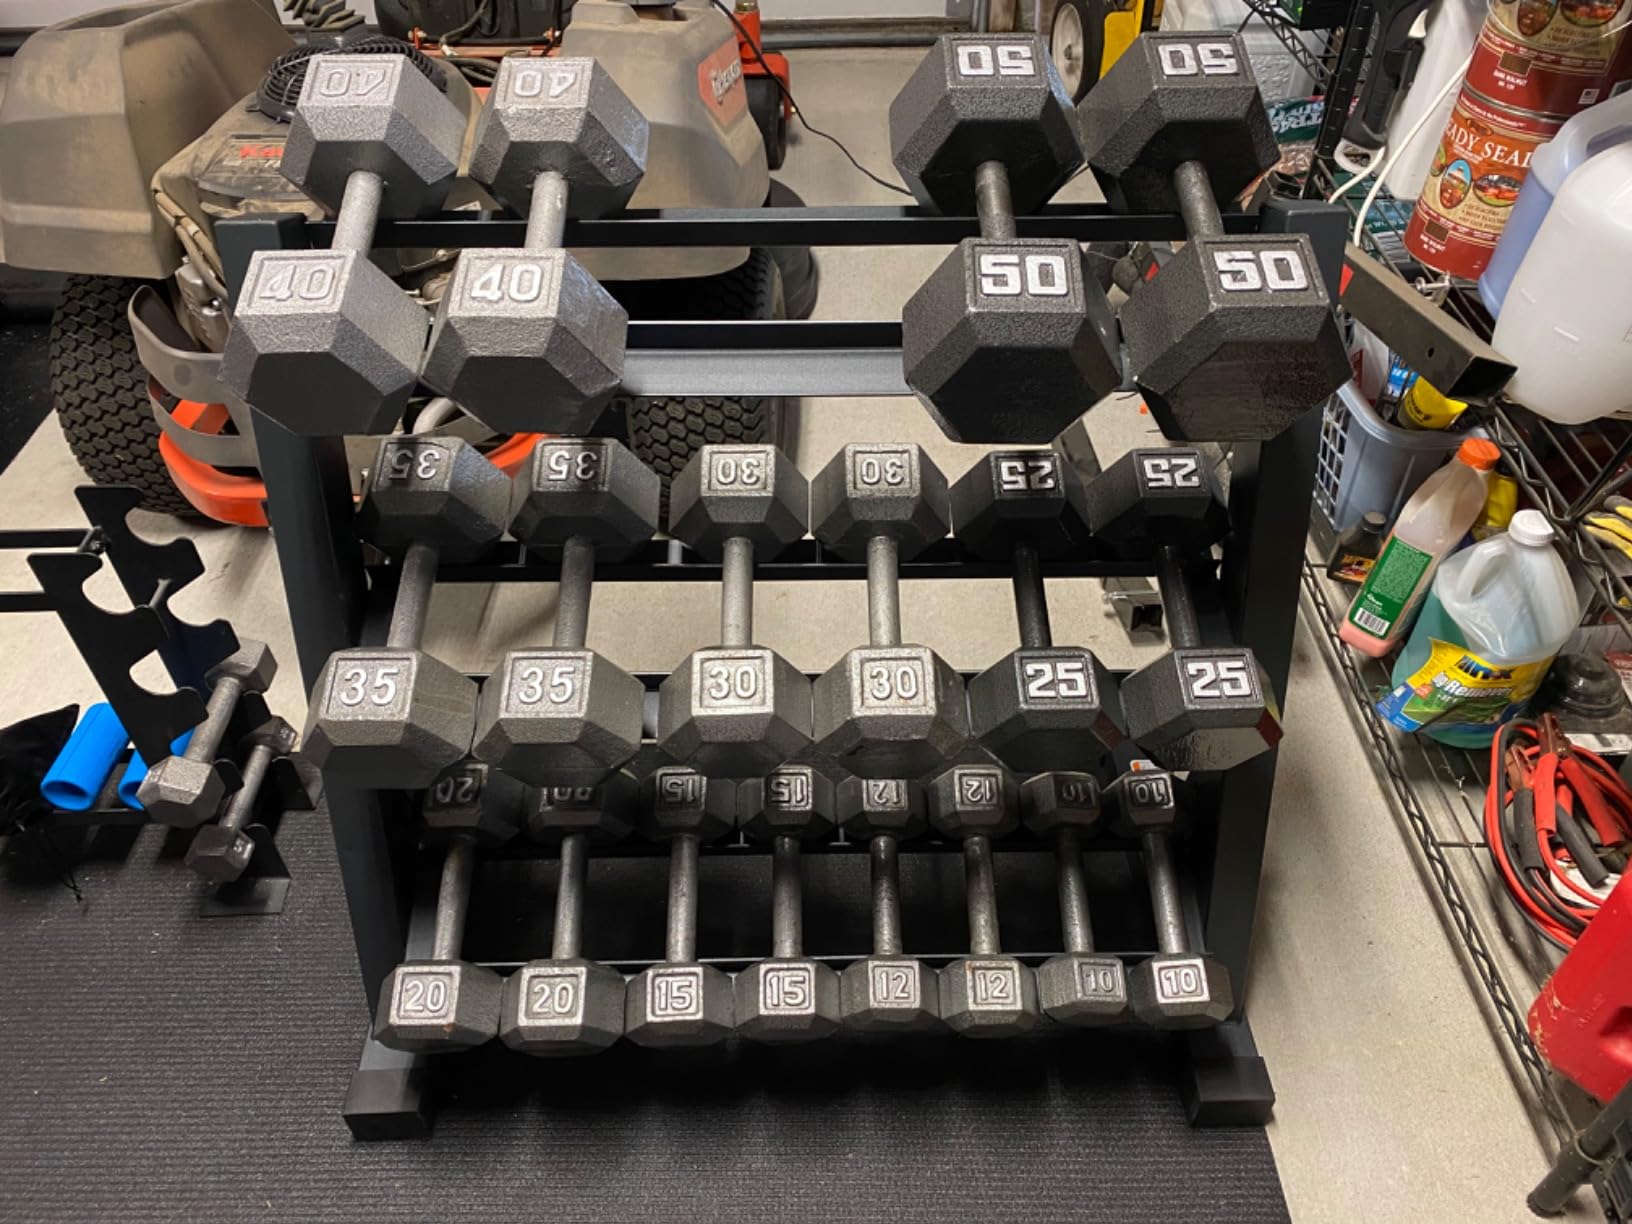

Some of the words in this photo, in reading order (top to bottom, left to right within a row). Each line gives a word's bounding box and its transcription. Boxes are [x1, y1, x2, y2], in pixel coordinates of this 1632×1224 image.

[957, 44, 1035, 76] 50
[1157, 43, 1238, 76] 50
[319, 66, 385, 97] 40
[514, 69, 576, 97] 40
[1446, 119, 1479, 151] EADY
[259, 263, 336, 301] 40
[470, 263, 543, 302] 40
[980, 253, 1068, 296] 50
[1214, 250, 1309, 292] 50
[389, 449, 440, 480] 35
[548, 449, 598, 481] 35
[716, 458, 760, 485] 30
[861, 458, 904, 485] 30
[1000, 460, 1055, 490] 25
[1143, 458, 1200, 488] 25
[340, 667, 399, 706] 35
[518, 666, 575, 704] 35
[708, 665, 757, 700] 30
[870, 665, 918, 700] 30
[1026, 661, 1088, 698] 25
[1187, 660, 1252, 698] 25
[665, 779, 695, 802] 15
[769, 778, 804, 803] 15
[871, 779, 902, 805] 12
[965, 779, 997, 802] 12
[1134, 781, 1166, 802] 10
[402, 979, 447, 1013] 20
[532, 981, 576, 1014] 20
[655, 978, 693, 1011] 15
[767, 971, 808, 1007] 15
[878, 969, 910, 1001] 12
[976, 971, 1009, 1002] 12
[1085, 969, 1114, 994] 10
[1163, 967, 1199, 996] 10
